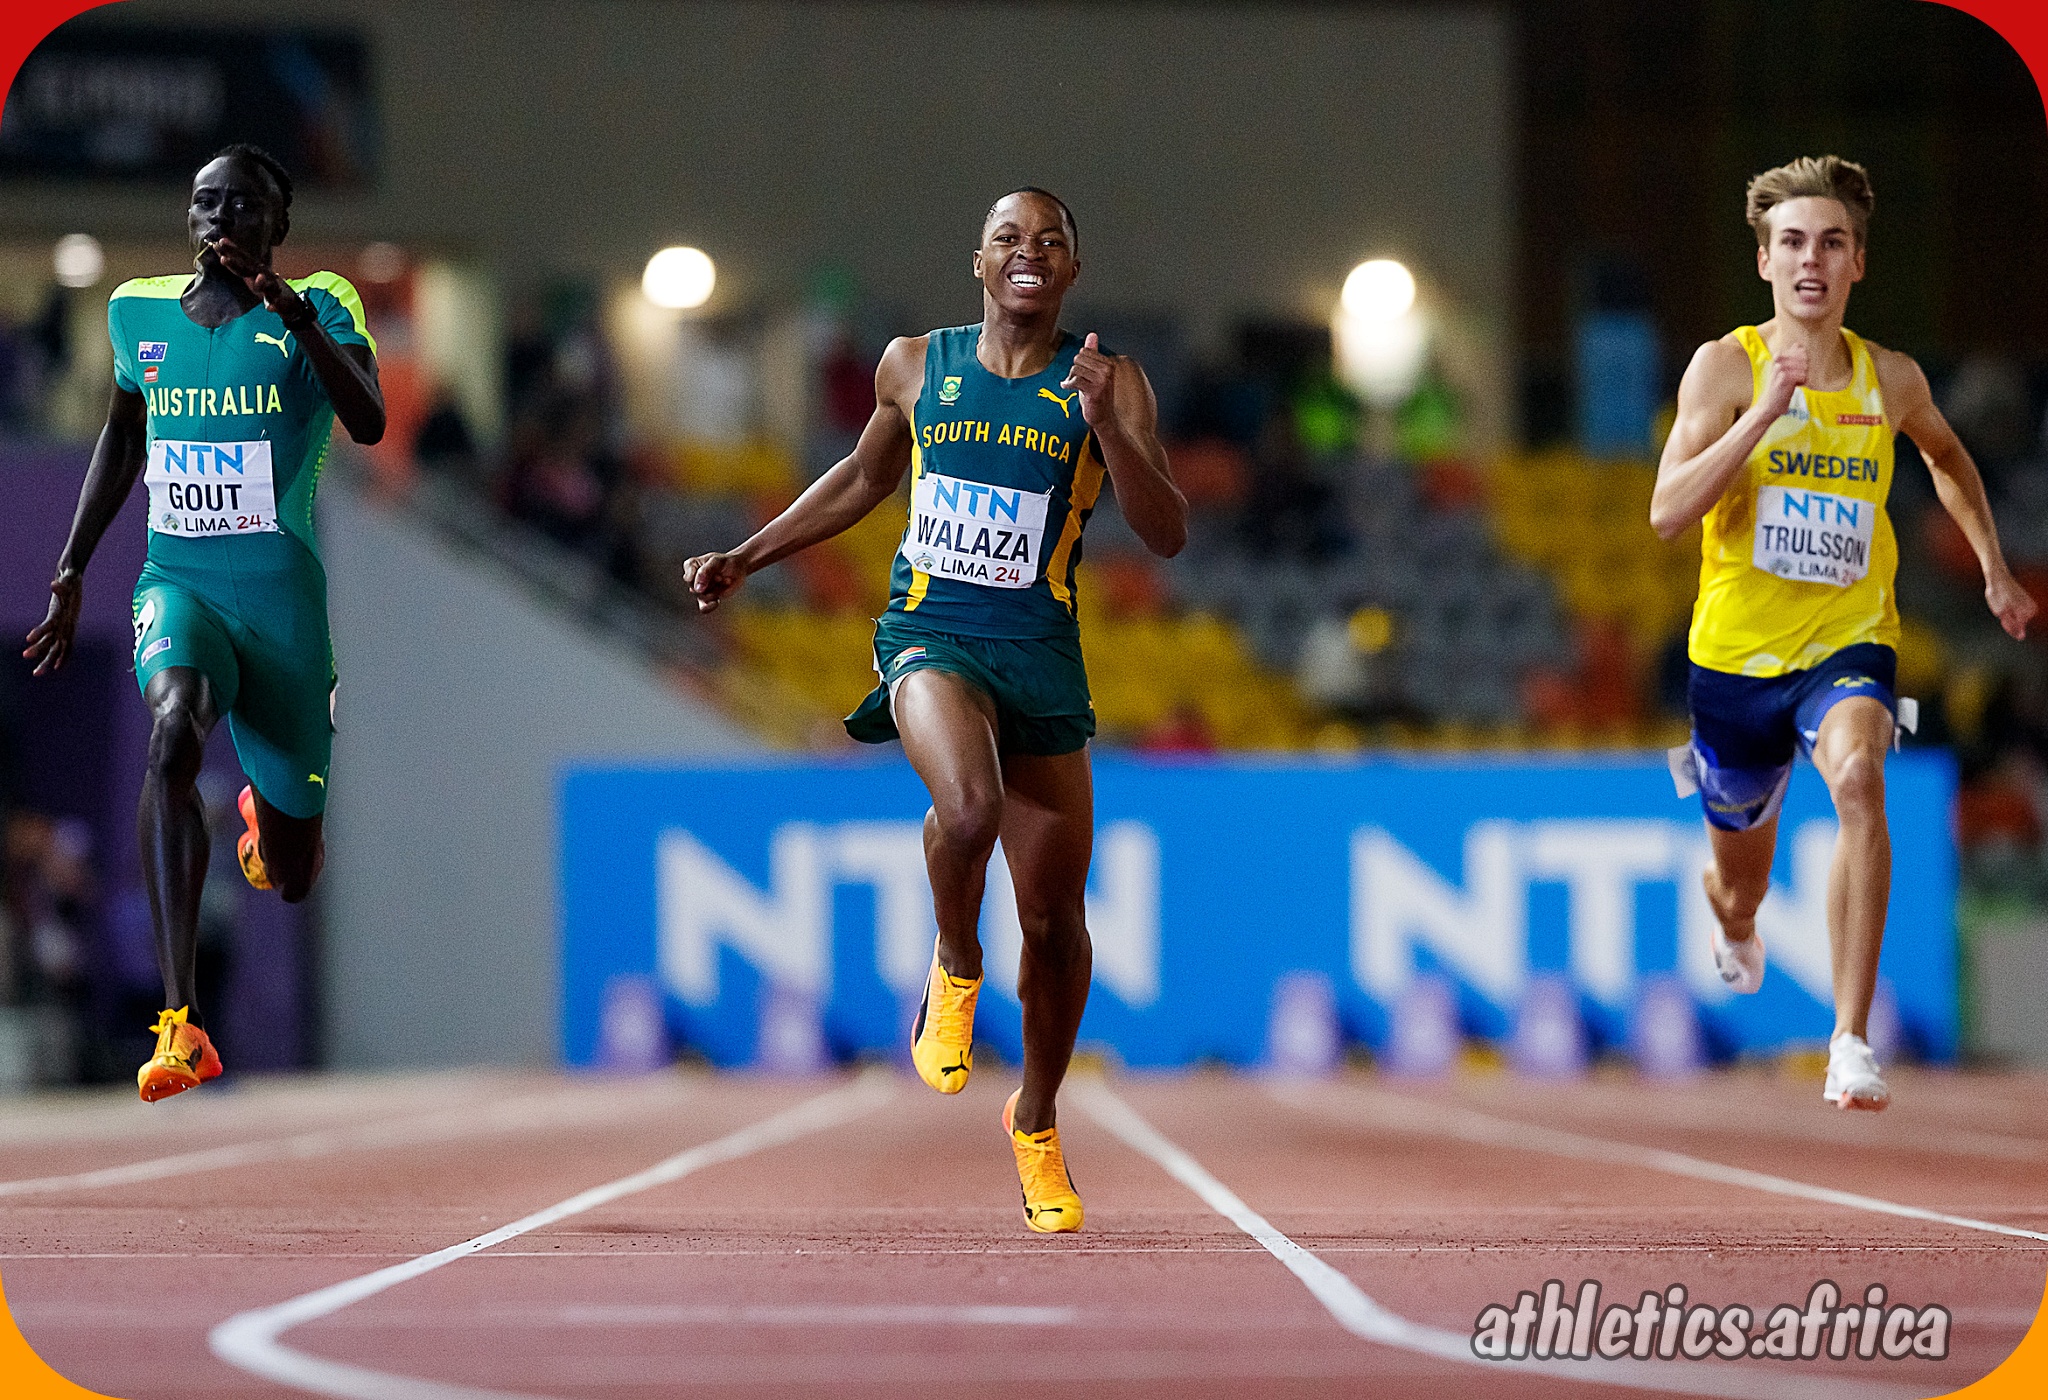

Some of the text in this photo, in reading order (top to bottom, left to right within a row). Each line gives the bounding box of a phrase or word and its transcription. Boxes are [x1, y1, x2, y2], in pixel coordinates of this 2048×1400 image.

[149, 384, 283, 417] AUSTRALIA
[922, 420, 1071, 464] SOUTH AFRICA
[164, 443, 244, 476] NTN
[1768, 450, 1879, 482] SWEDEN
[169, 482, 243, 512] GOUT
[933, 477, 1021, 524] NTN
[1783, 491, 1859, 529] NTN
[184, 514, 262, 532] LIMA 24
[917, 513, 1030, 564] WALAZA
[1762, 525, 1867, 567] TRULSSON
[941, 556, 1021, 584] LIMA 24
[1798, 561, 1839, 579] LIMA
